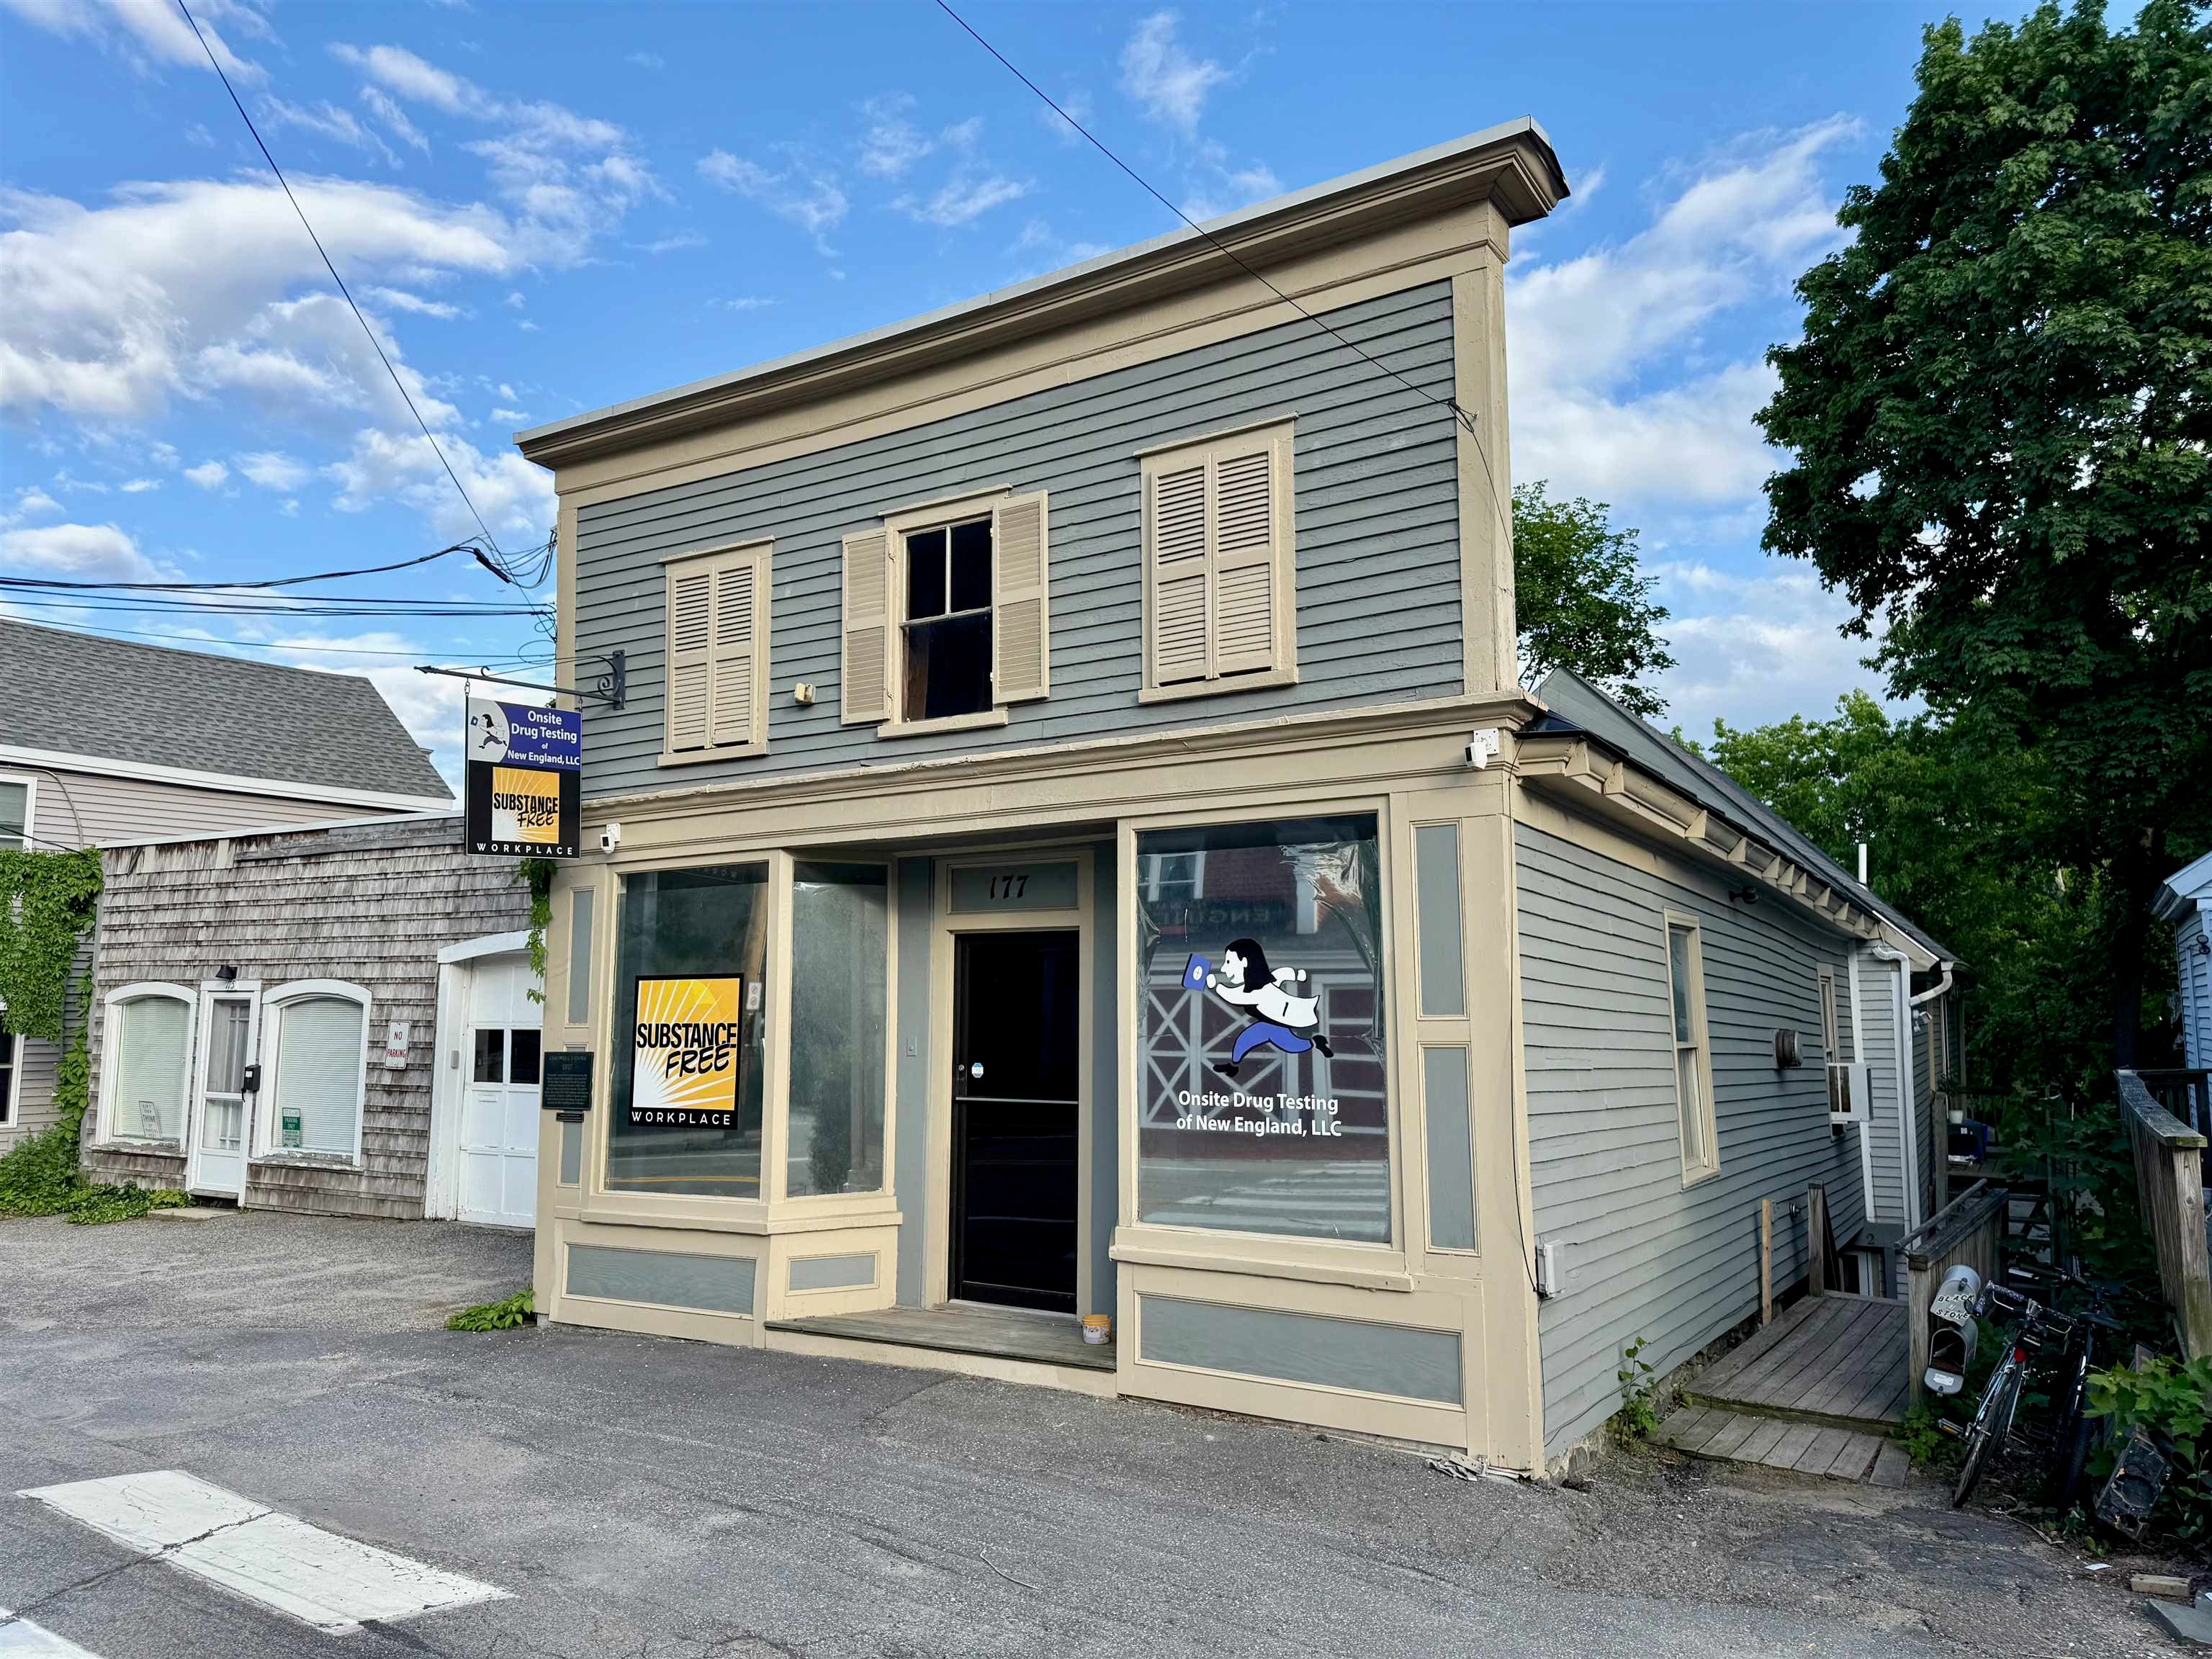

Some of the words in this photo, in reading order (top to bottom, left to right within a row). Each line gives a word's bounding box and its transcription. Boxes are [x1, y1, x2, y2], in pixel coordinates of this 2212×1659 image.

[528, 711, 562, 724] Onsite
[511, 724, 538, 739] Drug
[540, 727, 577, 744] Testing
[508, 750, 527, 760] New
[529, 752, 565, 765] England,
[565, 757, 580, 765] LLC
[493, 793, 558, 814] SUBSTANCE
[517, 811, 554, 827] FREE
[477, 842, 572, 855] WORKPLACE
[990, 876, 1030, 899] 177
[394, 1031, 403, 1040] NO
[637, 1022, 737, 1048] SUBSTANCE
[387, 1048, 406, 1058] PARKING
[665, 1043, 730, 1079] FREE
[1178, 1090, 1229, 1107] Onsite
[1233, 1092, 1274, 1112] Drug
[1277, 1093, 1339, 1115] Testing
[631, 1111, 731, 1125] WORKPLACE
[1176, 1114, 1193, 1130] of
[1196, 1115, 1231, 1131] New
[1234, 1117, 1308, 1138] England,
[1311, 1120, 1342, 1136] LLC
[1866, 1233, 1875, 1245] 2
[1938, 1294, 1974, 1303] BLACK
[1936, 1308, 1969, 1319] STONE
